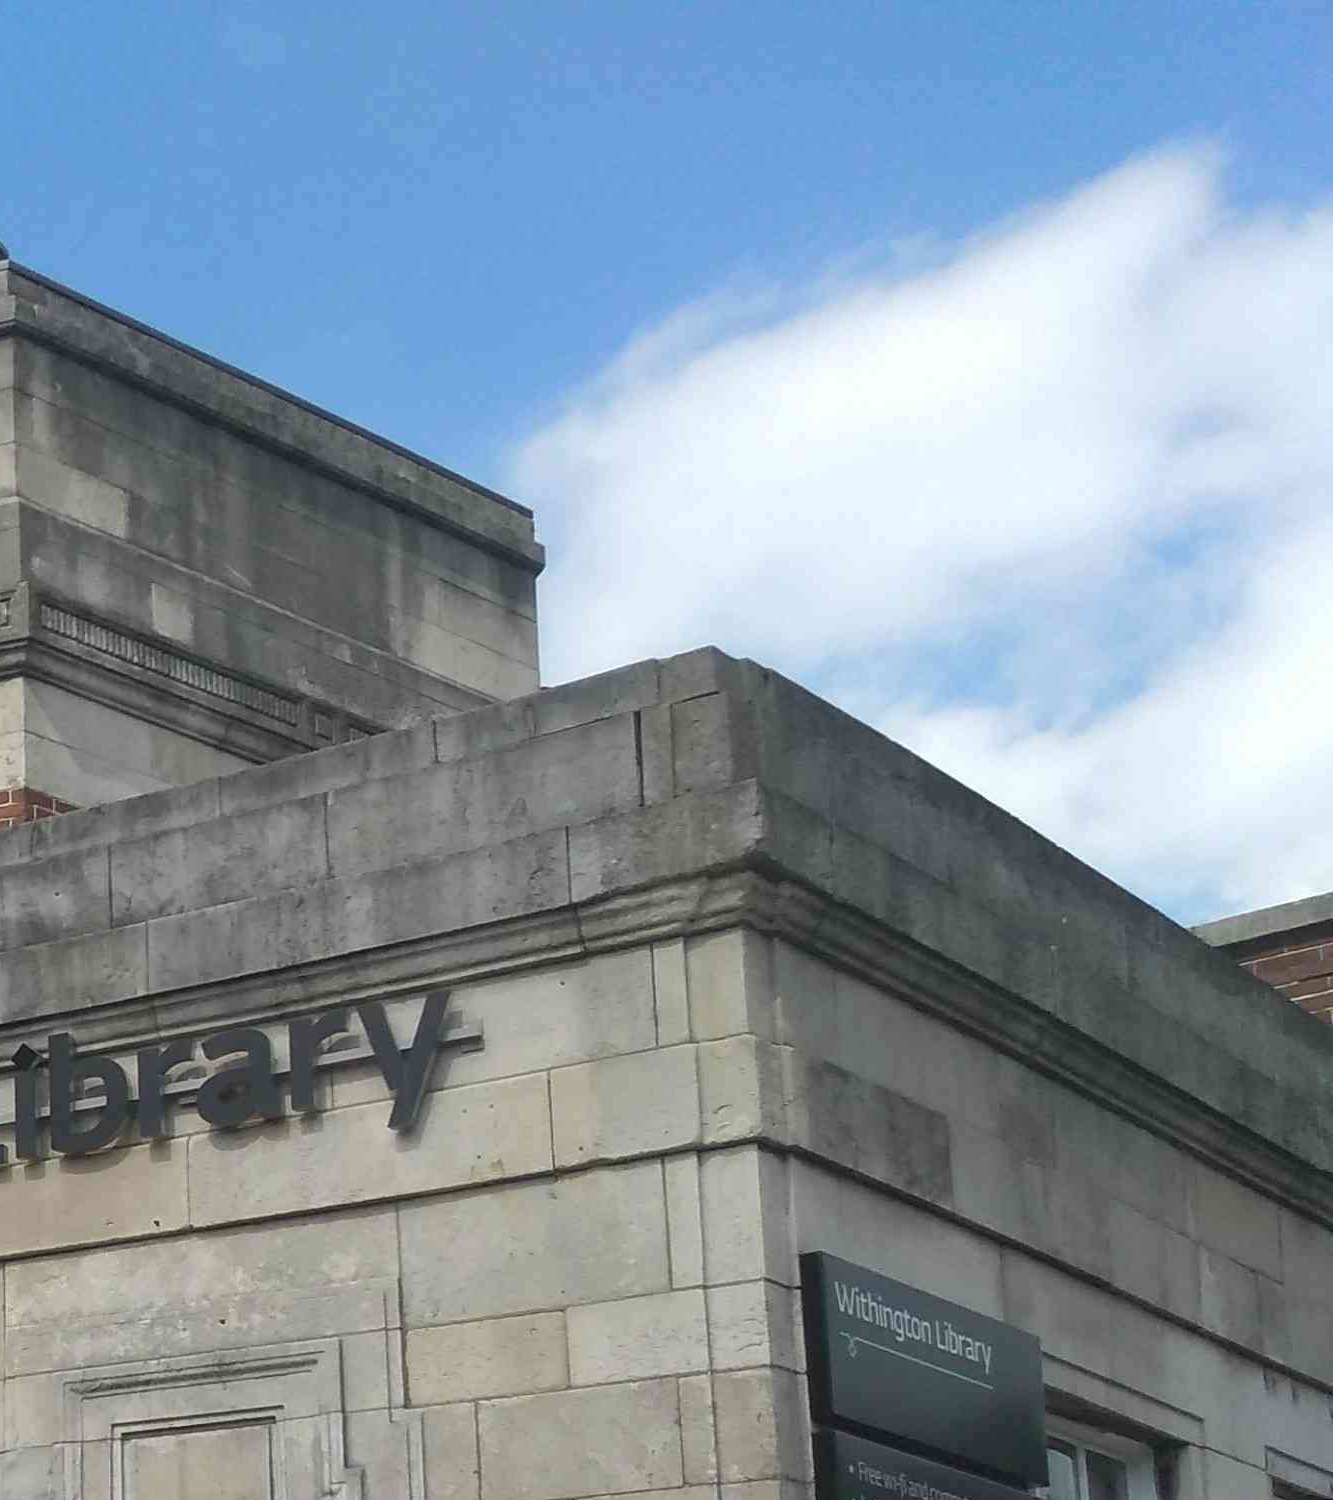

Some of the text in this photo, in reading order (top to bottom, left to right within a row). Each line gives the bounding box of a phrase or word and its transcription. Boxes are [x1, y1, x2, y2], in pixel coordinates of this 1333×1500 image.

[835, 1281, 992, 1374] Withington Library
[857, 1461, 883, 1487] Free
[908, 1480, 929, 1500] and
